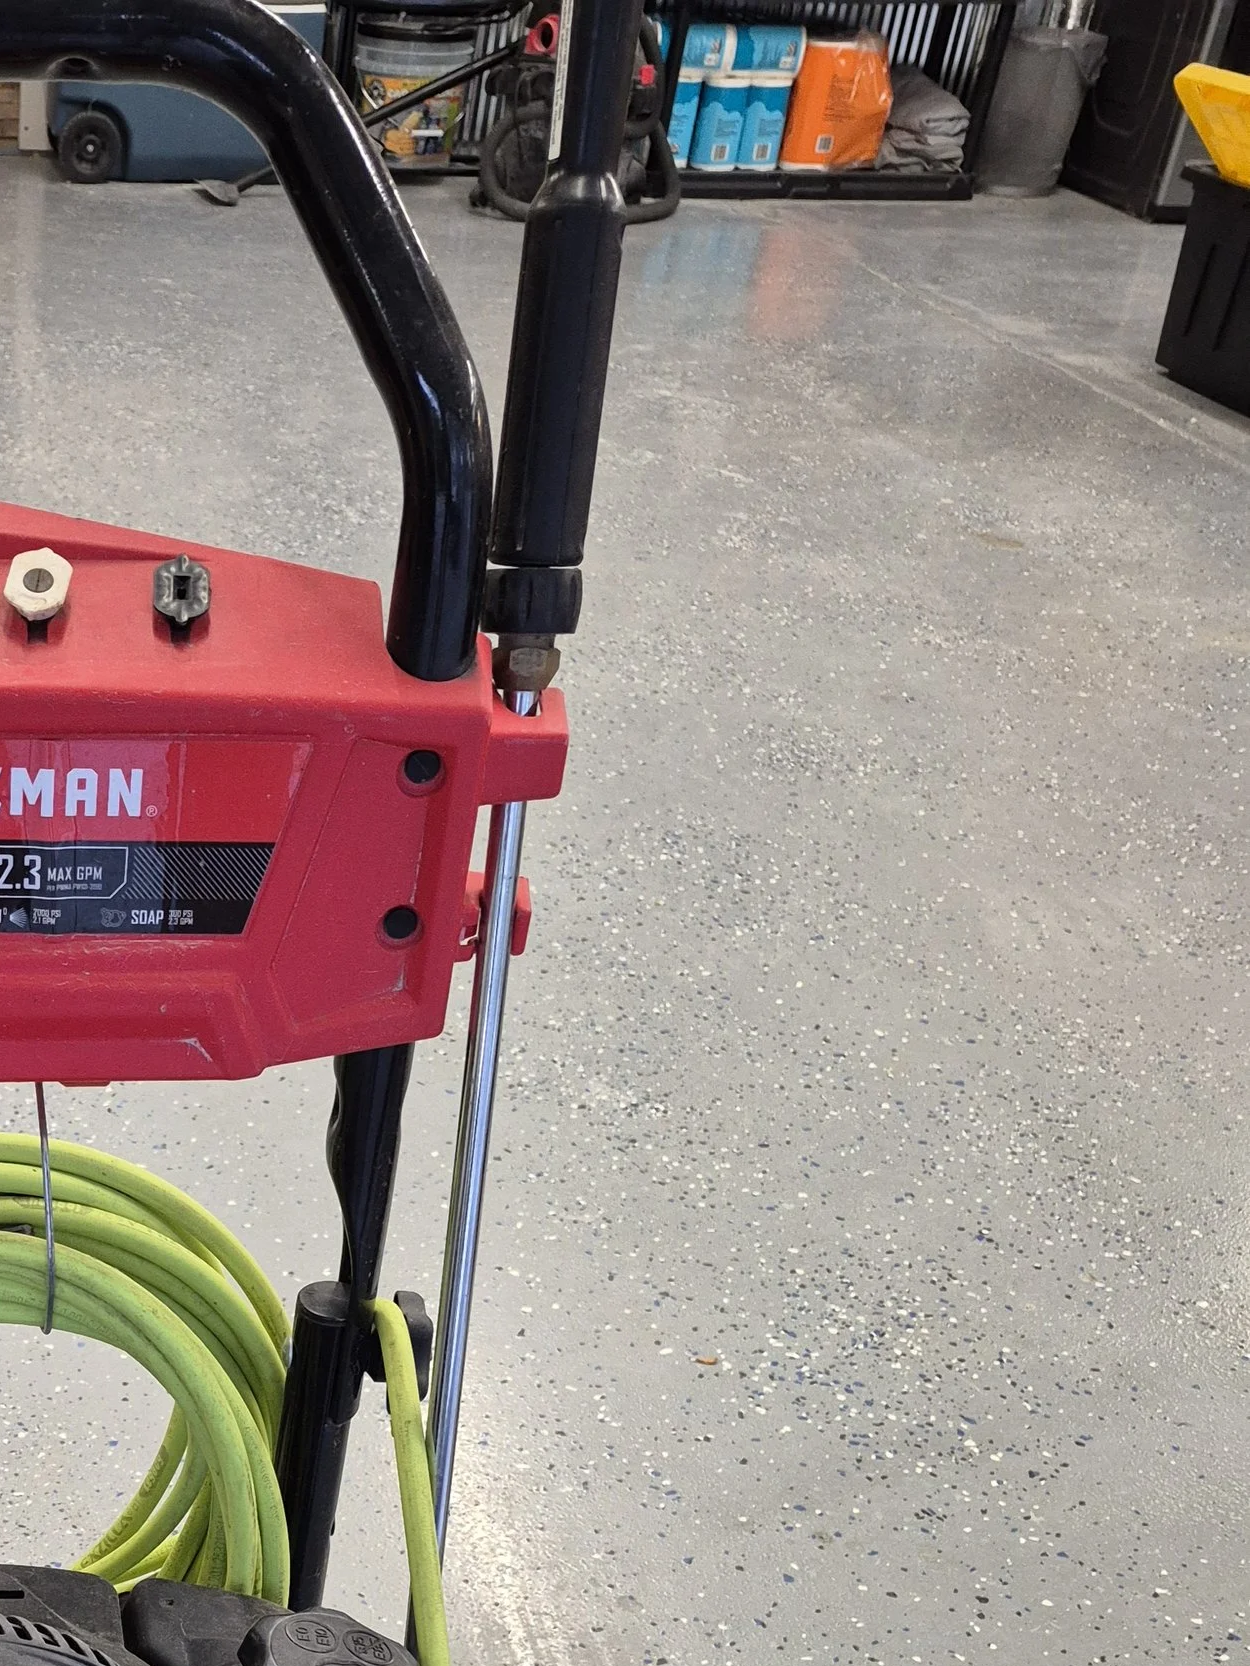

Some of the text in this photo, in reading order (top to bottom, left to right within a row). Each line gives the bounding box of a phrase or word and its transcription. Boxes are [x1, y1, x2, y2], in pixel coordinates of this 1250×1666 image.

[47, 867, 73, 881] MAX
[76, 867, 103, 880] GPM
[131, 910, 164, 925] SOAP
